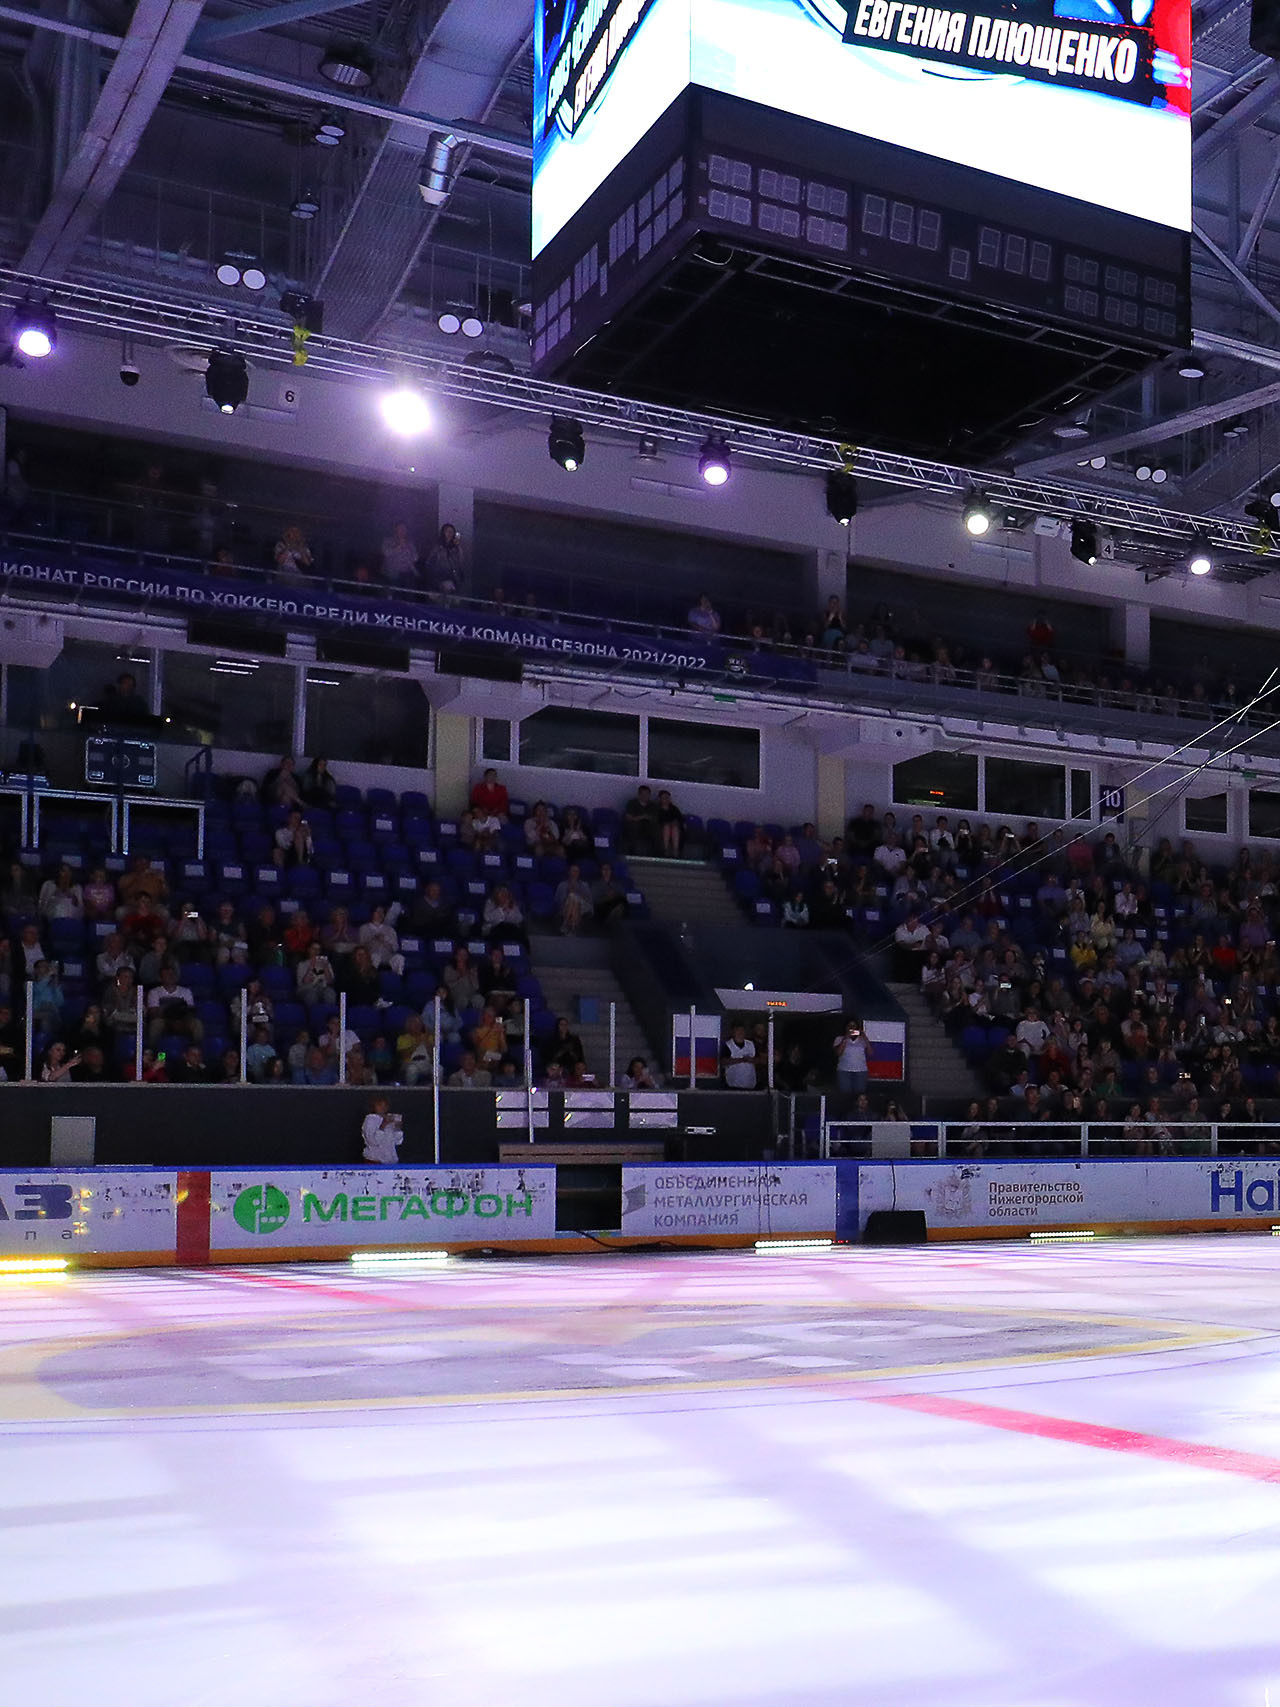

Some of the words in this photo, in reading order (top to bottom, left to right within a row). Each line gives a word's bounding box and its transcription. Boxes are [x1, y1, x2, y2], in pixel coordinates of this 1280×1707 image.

[853, 0, 967, 53] ЕВГЕНИЯ
[967, 15, 1139, 84] ПЛЮЩЕНКО
[285, 390, 295, 402] 6
[1104, 544, 1111, 554] 4
[83, 571, 170, 597] РОССИИ
[176, 586, 205, 602] ПО
[210, 592, 298, 615] ХОККЕЮ
[303, 603, 369, 624] СРЕДИ
[374, 611, 467, 636] ЖЕНСКИХ
[472, 626, 547, 649] КОМАНД
[551, 638, 617, 658] СЕЗОНА
[622, 648, 707, 669] 2021/2022
[1103, 789, 1121, 808] 10
[989, 1182, 1080, 1194] Правительство
[654, 1193, 808, 1209] МЕТАЛЛУРГИЧЕСКАЯ
[989, 1192, 1084, 1206] Нижегородской
[302, 1191, 533, 1222] МЕГАФОН
[989, 1206, 1038, 1217] области
[654, 1213, 739, 1227] КОМПАНИЯ
